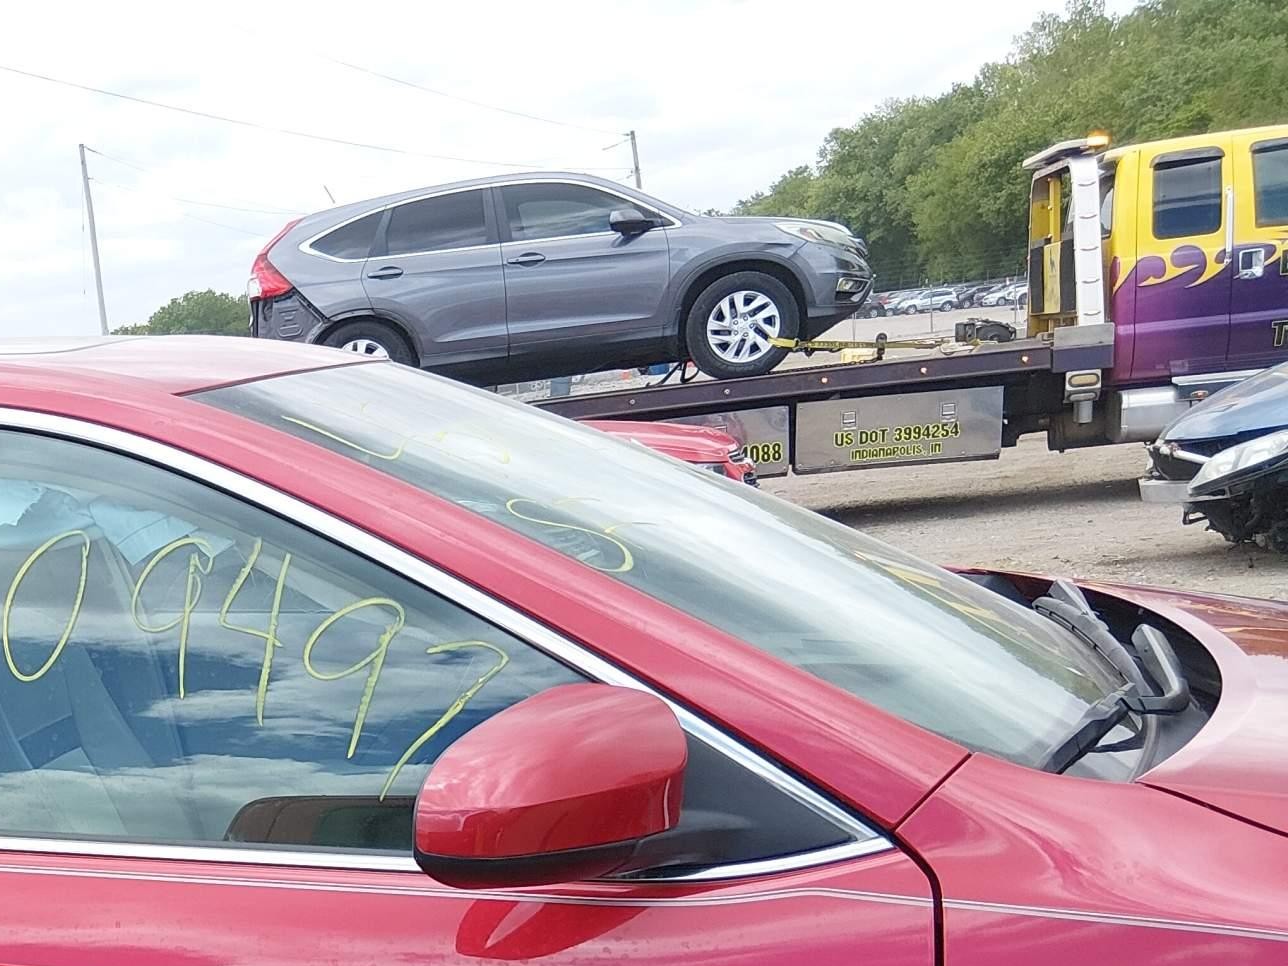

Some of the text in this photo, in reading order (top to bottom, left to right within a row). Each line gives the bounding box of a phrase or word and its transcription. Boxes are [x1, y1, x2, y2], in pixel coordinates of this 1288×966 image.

[834, 421, 960, 447] US DOT 3994254
